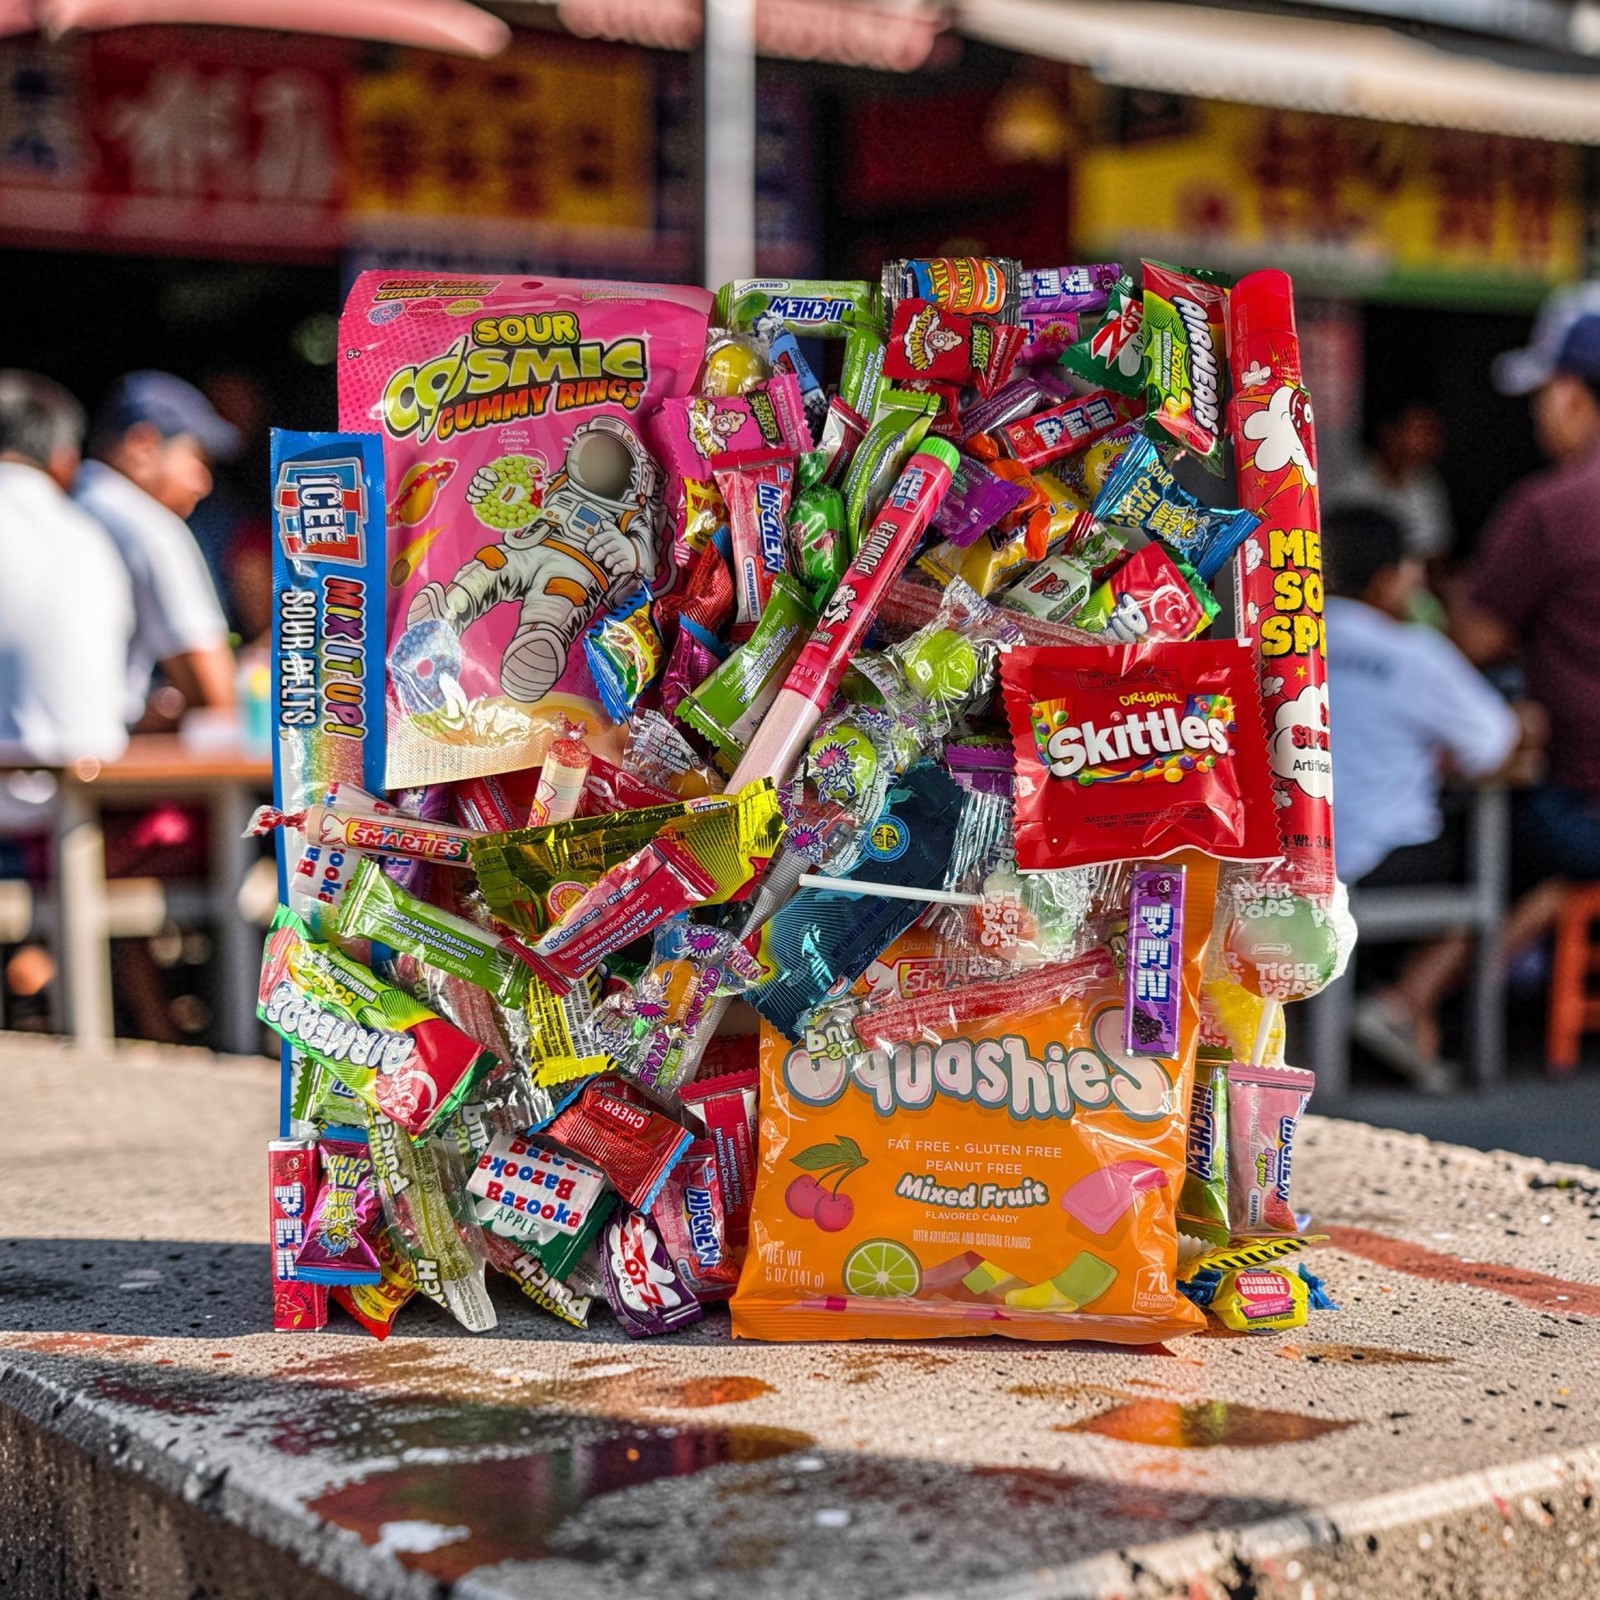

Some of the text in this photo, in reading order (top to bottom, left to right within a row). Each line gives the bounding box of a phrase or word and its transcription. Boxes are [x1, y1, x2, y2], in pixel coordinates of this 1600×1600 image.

[953, 258, 974, 309] WASTE
[475, 317, 577, 343] SOUR
[911, 306, 938, 371] WARHEADS
[972, 325, 983, 368] EXTREME
[346, 350, 361, 360] 5+
[1171, 295, 1219, 438] AIRHEADS
[1171, 345, 1184, 389] SOUR
[385, 338, 645, 436] COSMIC
[438, 380, 645, 438] GUMMY RINGS
[1034, 397, 1114, 449] PEZ
[1145, 460, 1175, 488] SOUR
[296, 474, 347, 544] ICEE
[757, 484, 787, 574] HI-CHEW
[1127, 490, 1161, 528] HARD
[1149, 502, 1169, 529] JAW
[1161, 506, 1188, 541] LOCK
[853, 520, 899, 577] POWDER
[746, 562, 758, 616] STRAWBERRY
[279, 589, 317, 726] SOUR BELTS
[324, 577, 366, 738] MIX IT UP!
[1048, 708, 1229, 777] Skittles
[352, 829, 463, 858] SMARTIES
[545, 908, 601, 950] hi-chew.com
[607, 877, 640, 906] #hichew
[559, 893, 650, 961] Natural and Artificial Flavors
[391, 922, 468, 961] Immensely Fruity
[411, 919, 485, 958] Intensely Chewy
[574, 905, 664, 974] Intensely Chewy Candy
[578, 909, 647, 962] Immensely Fruity
[1136, 902, 1175, 1003] PEZ
[332, 965, 379, 1003] WATERMELON
[444, 958, 475, 979] Natural
[265, 980, 415, 1076] AIRHEADS
[1157, 1011, 1172, 1036] GRAPE
[594, 1098, 645, 1129] CHERRY
[1186, 1084, 1214, 1182] HI-CHEW
[715, 1127, 728, 1167] Intensely
[735, 1121, 747, 1150] Natural
[888, 1139, 1062, 1158] FAT FREE GLUTEN FREE
[477, 1153, 577, 1201] Bazooka
[721, 1166, 731, 1194] Chewy
[726, 1137, 740, 1183] Immensely
[926, 1160, 1022, 1174] PEANUT FREE
[1264, 1147, 1277, 1182] Sweet
[484, 1180, 582, 1229] Bazooka
[898, 1174, 1048, 1208] Mixed Fruit
[273, 1183, 308, 1282] PEZ
[494, 1206, 540, 1236] APPLE
[685, 1187, 721, 1268] HI-CHEW
[925, 1211, 1019, 1223] FLAVORED CANDY
[766, 1248, 802, 1266] NET WT
[913, 1229, 1031, 1250] WITH ARTIFICIAL AND NATURAL FLAVORS
[511, 1253, 594, 1324] PUNCH
[616, 1259, 635, 1298] GRAPE
[765, 1266, 825, 1288] 5 OZ (141 g)
[1238, 1275, 1285, 1286] DUBBLE
[1240, 1285, 1288, 1296] BUBBLE
[520, 1278, 575, 1320] SOUR
